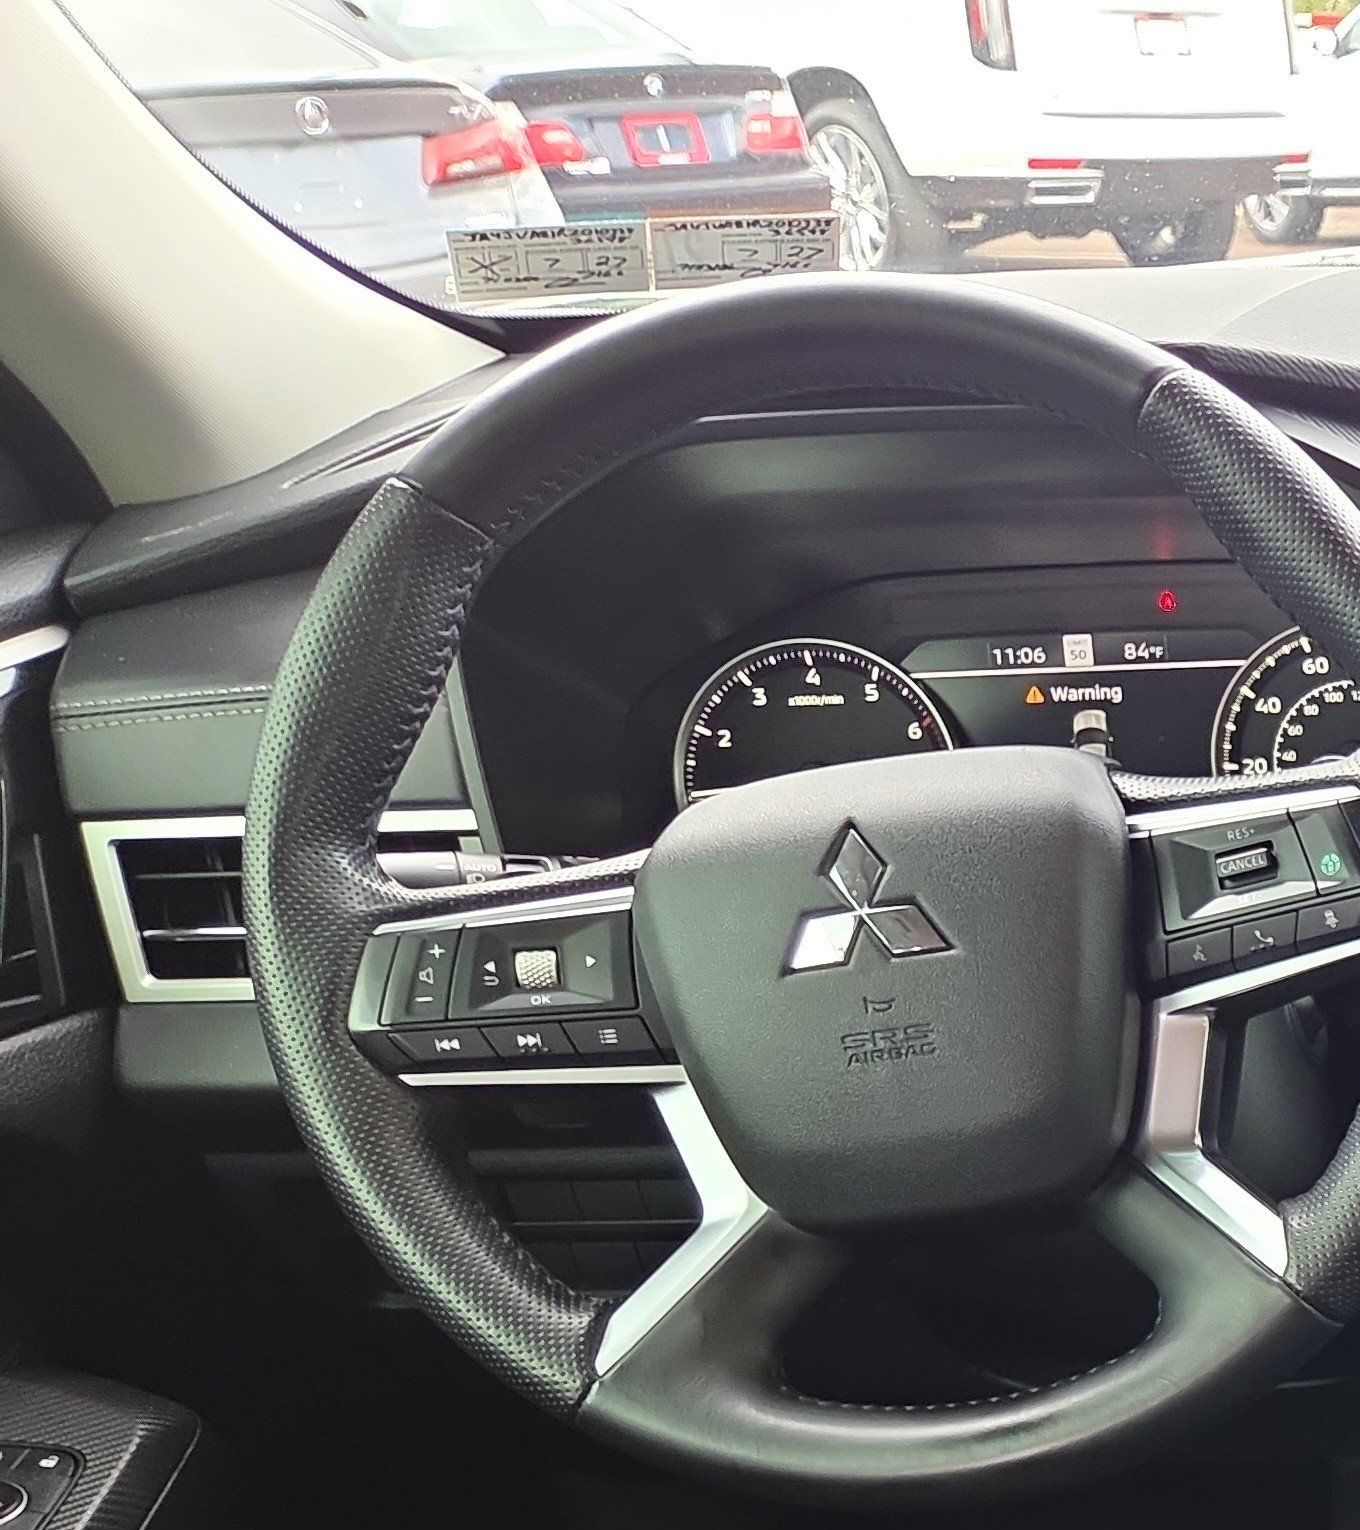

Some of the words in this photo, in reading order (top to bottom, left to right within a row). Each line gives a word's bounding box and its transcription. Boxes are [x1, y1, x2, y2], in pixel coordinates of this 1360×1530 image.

[992, 646, 1047, 666] 11:06
[1070, 649, 1087, 660] 50
[1302, 656, 1330, 675] 60
[805, 668, 821, 686] 4
[752, 688, 767, 706] 3
[865, 683, 880, 702] 5
[1050, 683, 1123, 704] Warning
[1323, 692, 1344, 703] 100
[1254, 696, 1282, 714] 40
[1303, 704, 1319, 716] 80
[717, 729, 733, 748] 2
[907, 722, 923, 740] 6
[1287, 725, 1304, 736] 60
[1281, 750, 1297, 762] 40
[1241, 757, 1268, 775] 20
[463, 862, 497, 872] AUTO
[1219, 853, 1266, 875] CANCEL
[530, 995, 551, 1006] OK
[840, 1023, 935, 1052] SRS
[847, 1042, 938, 1068] AIRBAG
